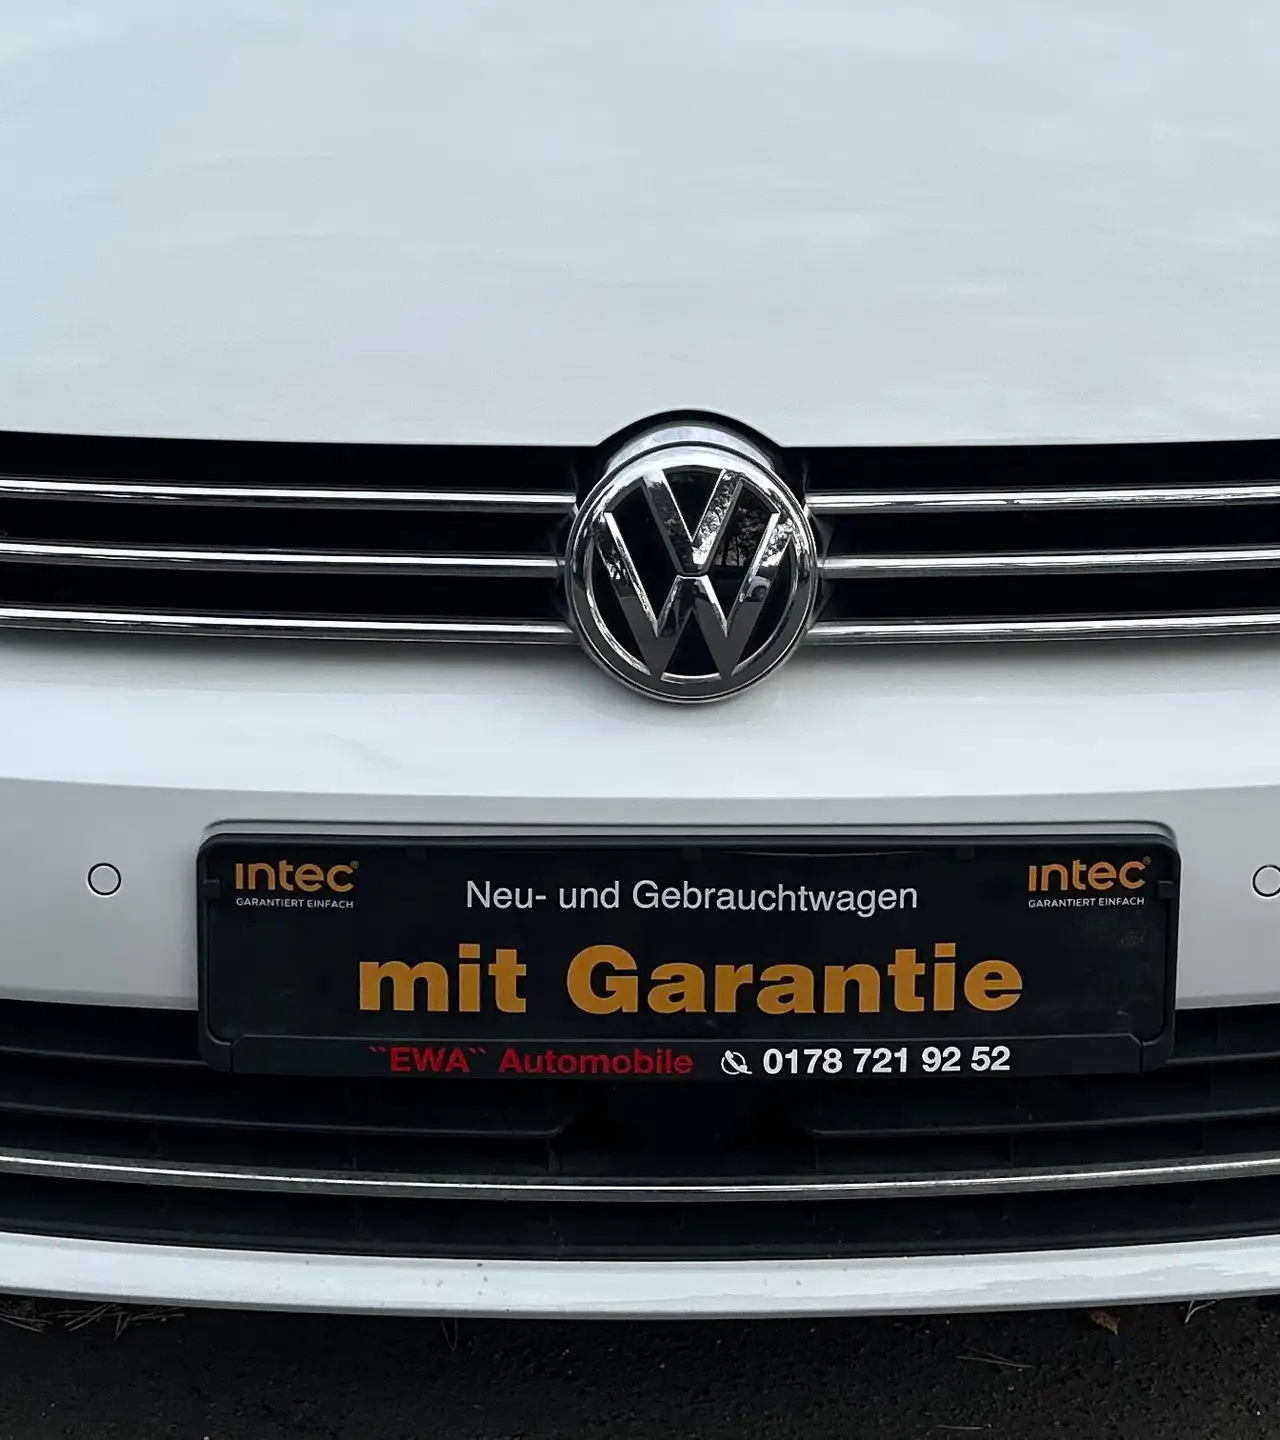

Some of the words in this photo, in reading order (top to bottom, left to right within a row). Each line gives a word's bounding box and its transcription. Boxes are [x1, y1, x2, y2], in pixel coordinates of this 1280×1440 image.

[235, 897, 305, 908] GARANTIERT
[307, 898, 354, 909] EINFACH
[466, 880, 547, 909] Neu-
[558, 880, 620, 909] und
[632, 880, 918, 918] Gebrauchtwagen
[1028, 898, 1096, 908] GARANTIERT
[1098, 897, 1145, 907] EINFACH
[359, 943, 527, 1013] mit
[566, 942, 1023, 1014] Garantie
[497, 1048, 694, 1075] Automobile
[763, 1048, 843, 1074] 0178
[853, 1047, 908, 1073] 721
[921, 1046, 961, 1073] 92
[971, 1045, 1011, 1072] 52
